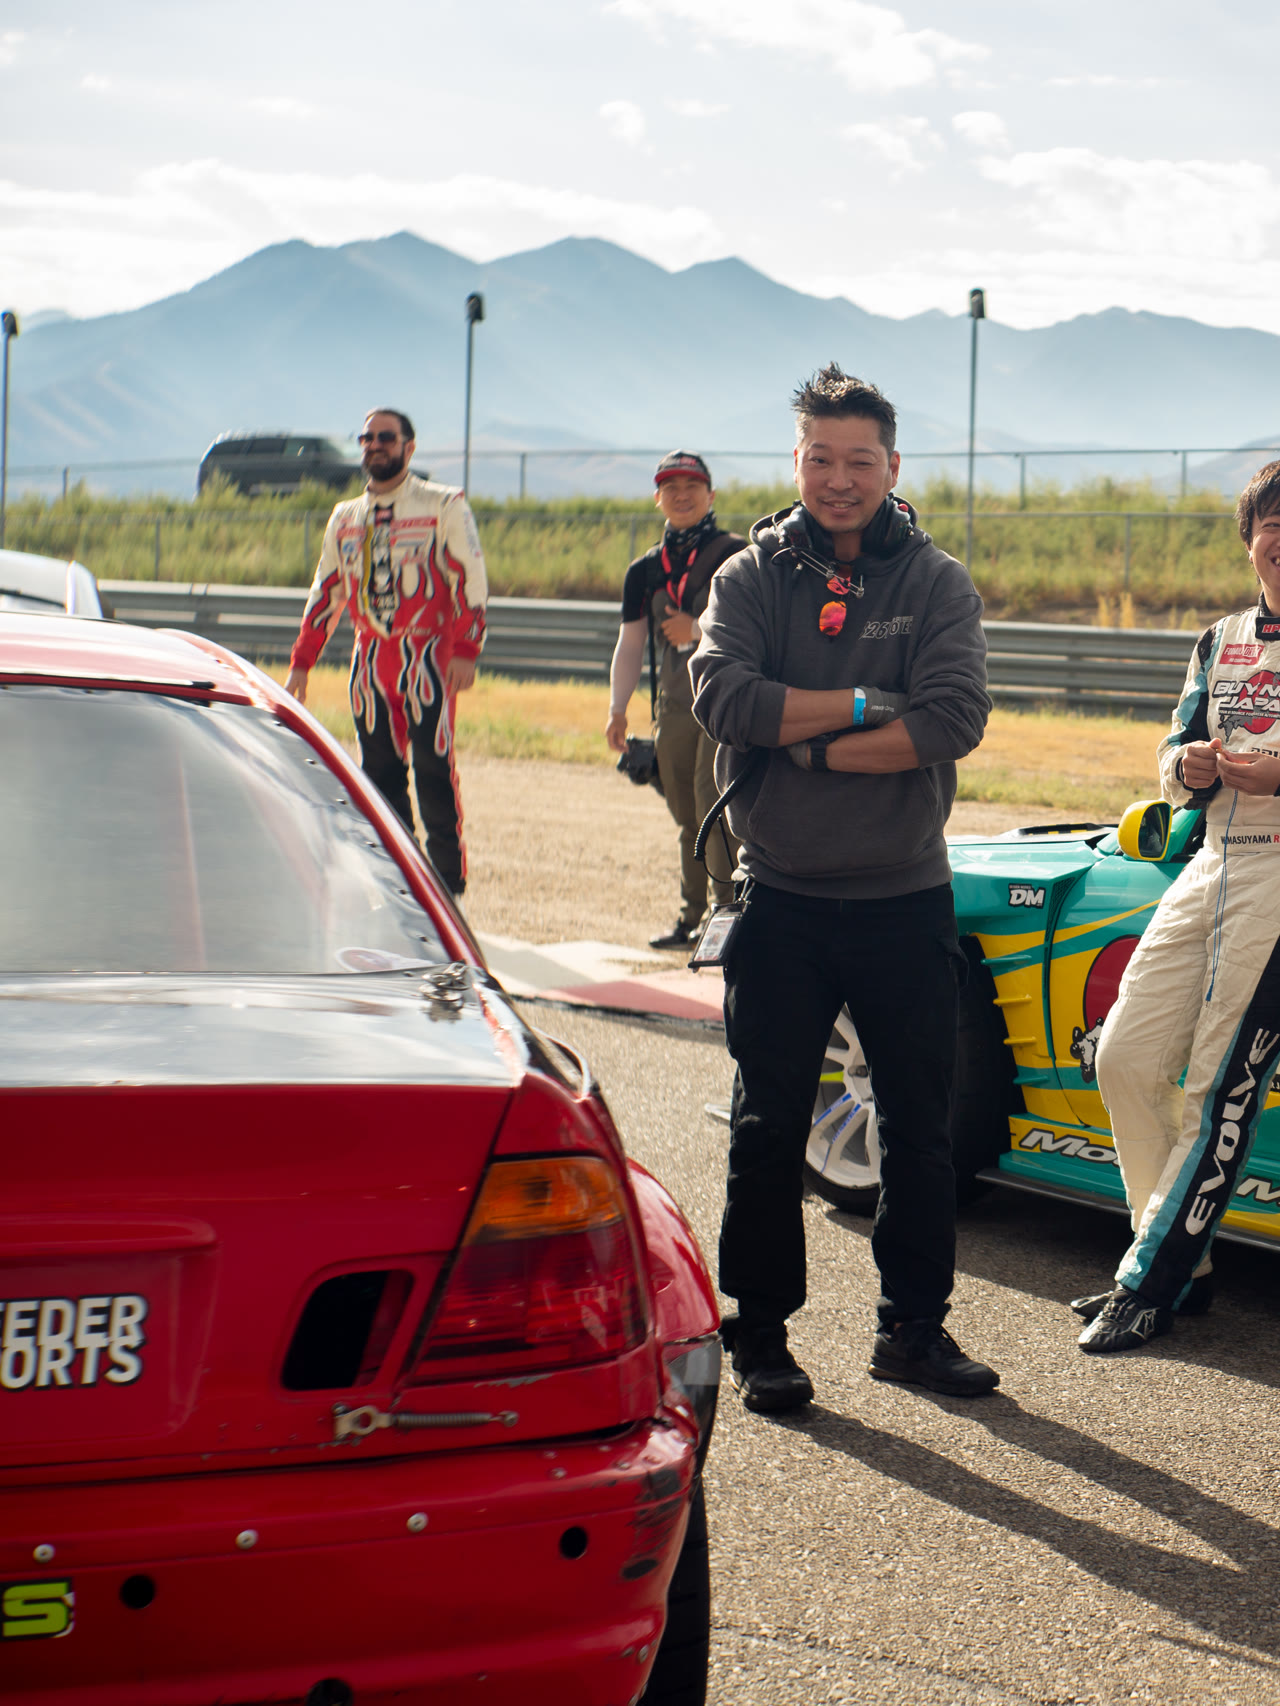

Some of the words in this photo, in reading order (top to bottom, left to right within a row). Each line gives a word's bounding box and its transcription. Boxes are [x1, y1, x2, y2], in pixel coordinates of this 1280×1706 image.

[1213, 682, 1260, 696] BUY
[1009, 889, 1045, 906] DM
[0, 1296, 147, 1348] EDER
[0, 1338, 142, 1389] ORTS
